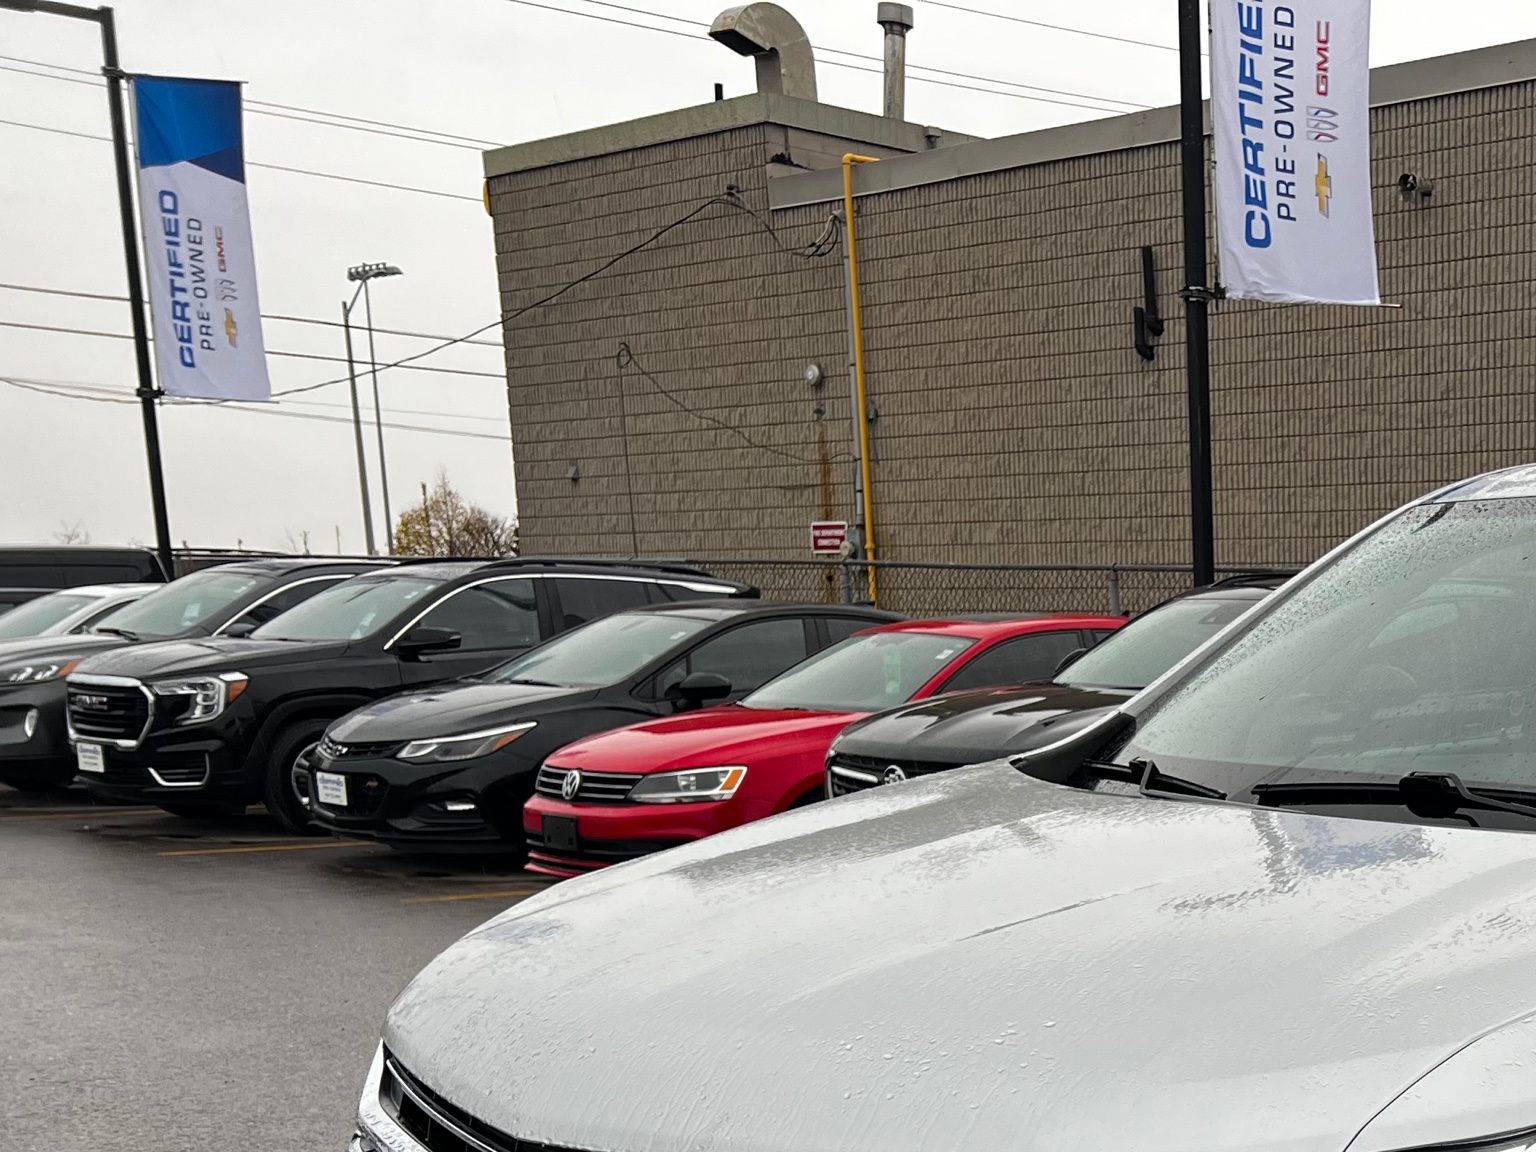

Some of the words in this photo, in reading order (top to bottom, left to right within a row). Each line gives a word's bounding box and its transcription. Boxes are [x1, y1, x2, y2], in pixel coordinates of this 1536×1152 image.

[1237, 0, 1272, 249] CERTIFIE
[1273, 6, 1297, 222] PRE-OWNED
[1316, 20, 1331, 97] GMC
[158, 189, 196, 368] CERTIFIED
[186, 217, 215, 352] PRE-OWNED
[214, 226, 227, 273] GMC
